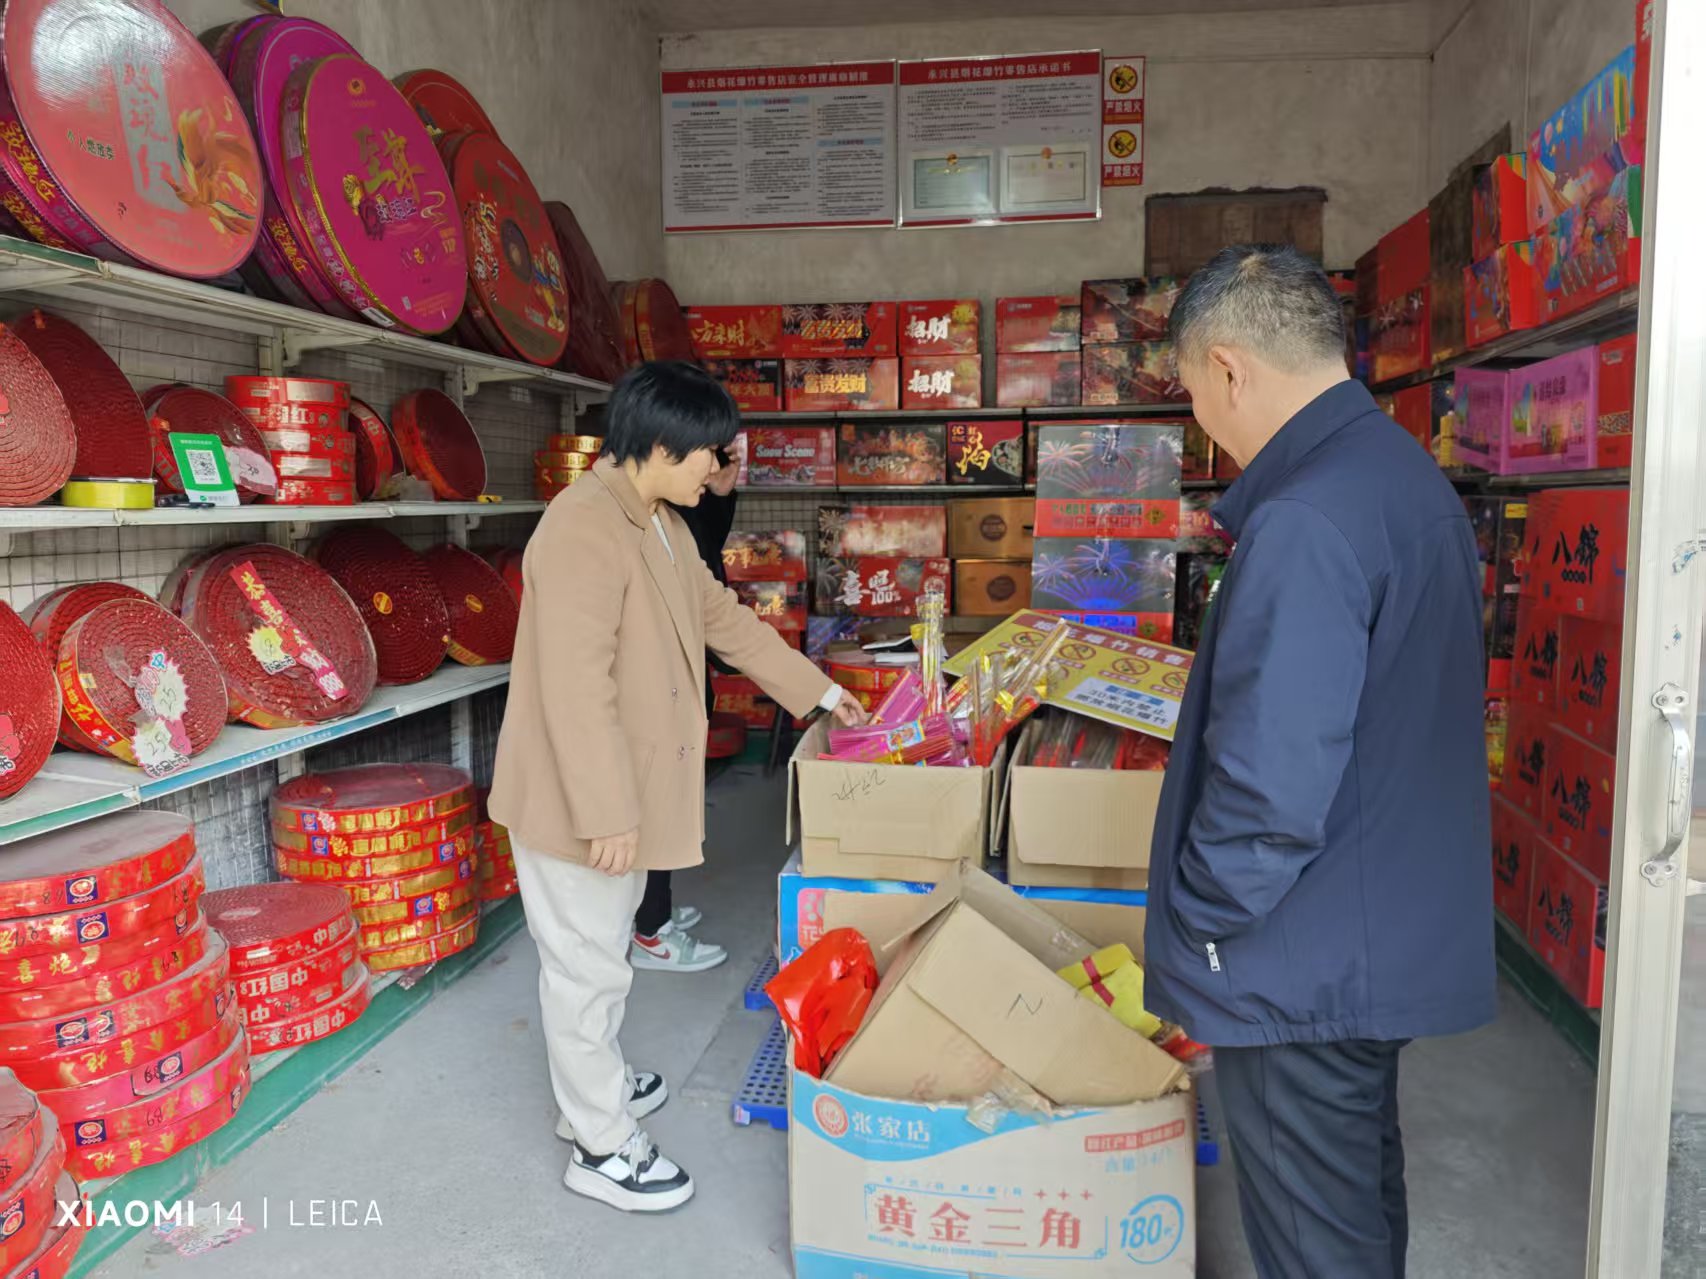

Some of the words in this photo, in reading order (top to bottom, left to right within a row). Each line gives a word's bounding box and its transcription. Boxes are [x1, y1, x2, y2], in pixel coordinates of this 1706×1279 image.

[873, 1195, 1083, 1250] 黄金三角
[1120, 1213, 1163, 1249] 180
